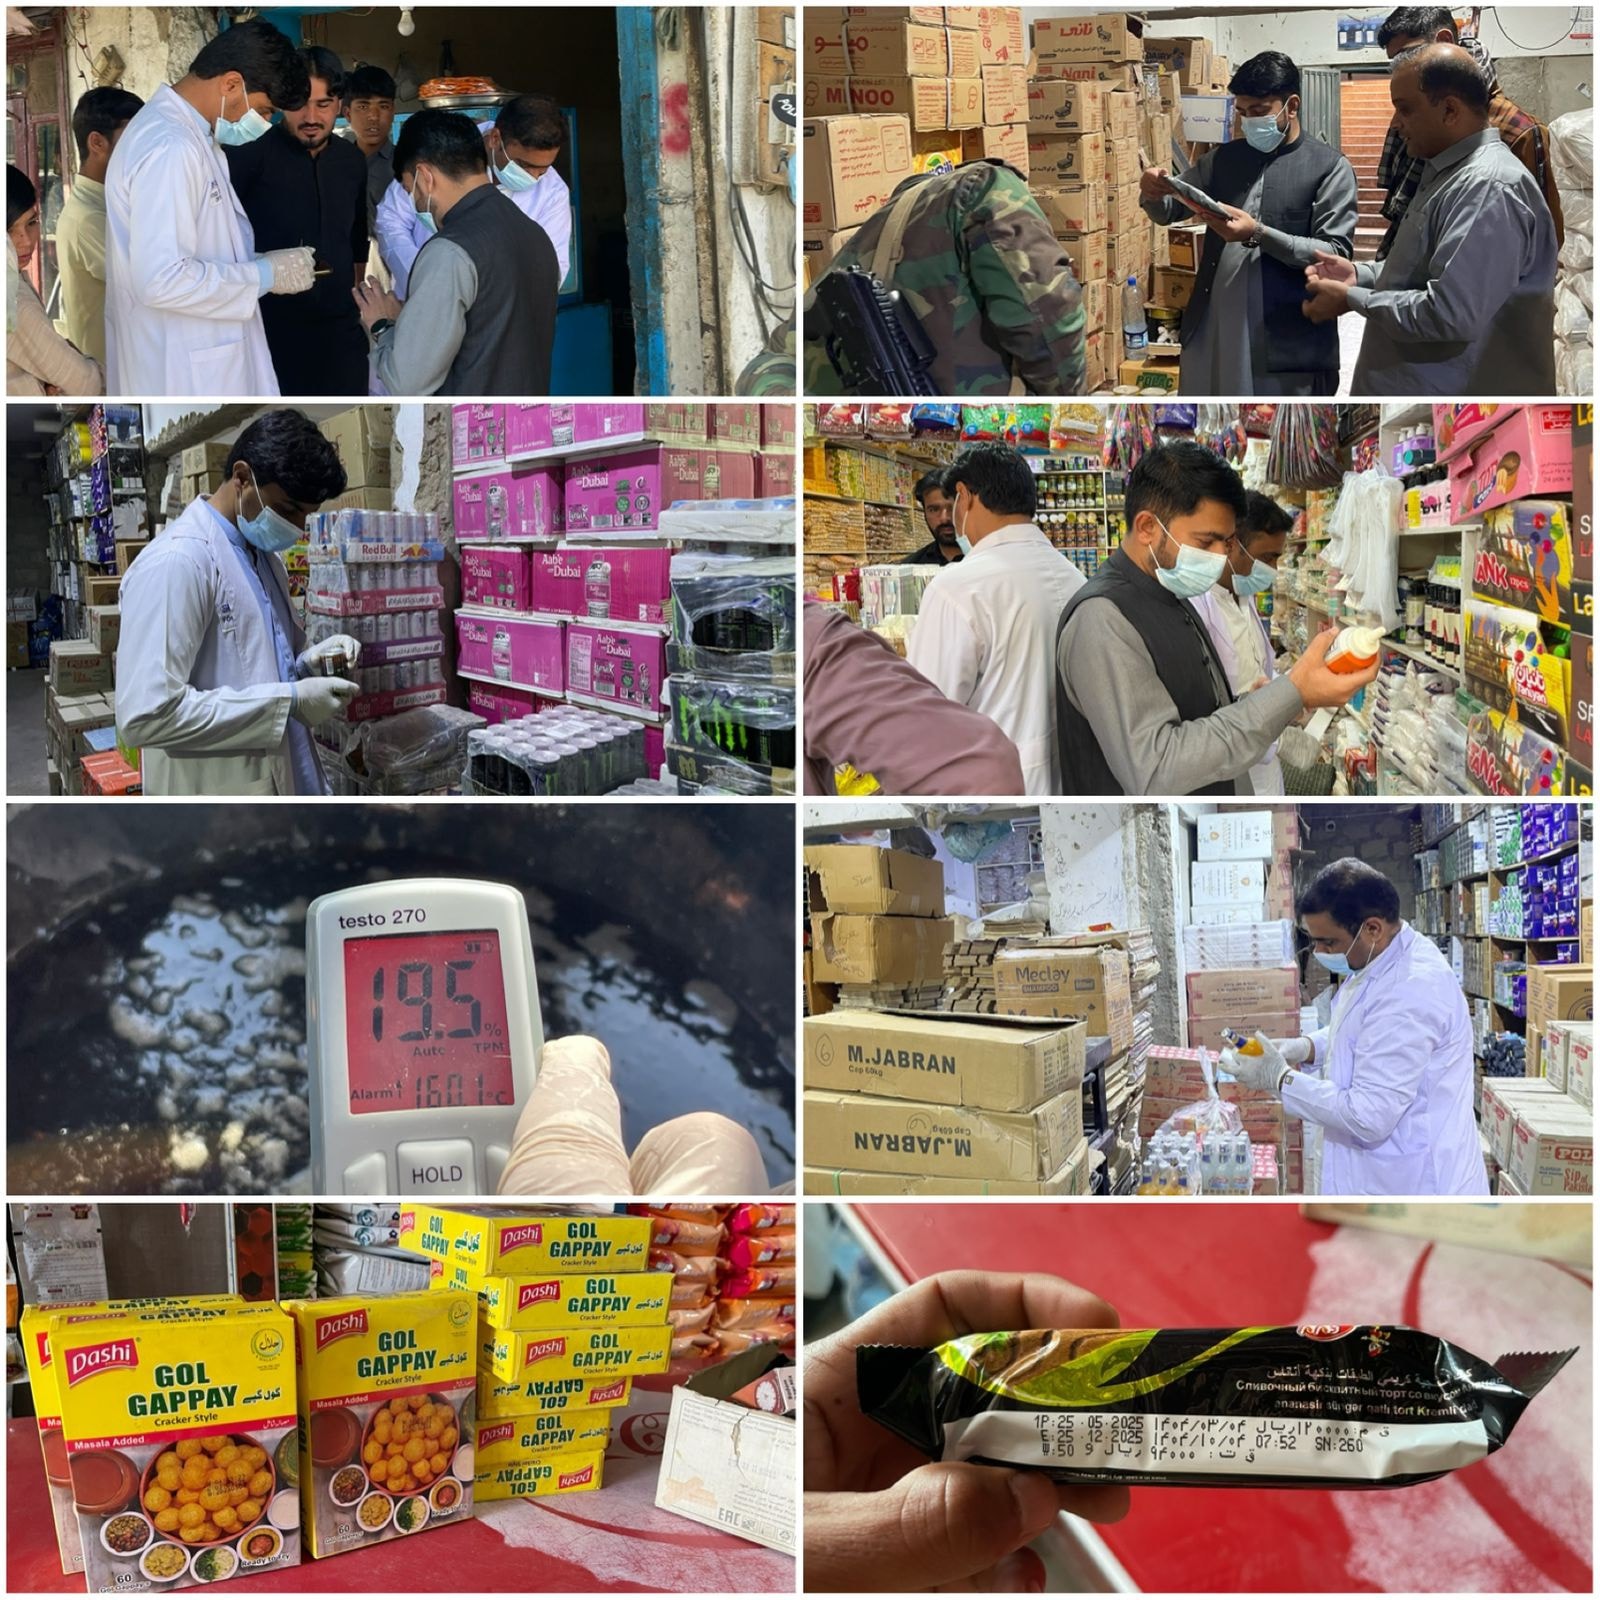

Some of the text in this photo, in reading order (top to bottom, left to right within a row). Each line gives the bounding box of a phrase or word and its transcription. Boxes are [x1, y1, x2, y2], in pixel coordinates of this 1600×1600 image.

[554, 565, 581, 577] Dubai
[339, 908, 427, 929] testo 270
[1016, 966, 1071, 984] Meclay
[372, 960, 482, 1042] 19.5
[413, 1046, 446, 1057] Auto
[848, 1045, 956, 1075] M.JABRAN
[350, 1088, 394, 1100] Alarm
[854, 1132, 972, 1157] M.JABRAN
[412, 1166, 463, 1184] HOLD
[1564, 1168, 1581, 1183] Sip
[430, 1216, 443, 1234] GOL
[567, 1222, 598, 1239] GOL
[421, 1233, 449, 1256] GAPPAY
[503, 1227, 540, 1247] Dashi
[550, 1241, 612, 1258] GAPPAY
[582, 1259, 597, 1267] Style
[522, 1284, 558, 1304] Dashi
[586, 1279, 616, 1294] GOL
[567, 1297, 632, 1312] GAPPAY
[139, 1309, 227, 1321] GAPPAY
[580, 1313, 616, 1322] Cracker Style
[320, 1314, 364, 1340] Dashi
[379, 1330, 417, 1352] GOL
[591, 1334, 619, 1349] GOL
[72, 1343, 132, 1375] Dashi
[529, 1341, 563, 1360] Dashi
[573, 1350, 632, 1366] GAPPAY
[357, 1350, 437, 1378] GAPPAY
[155, 1363, 210, 1387] GOL
[376, 1374, 422, 1387] Cracker Style
[526, 1378, 584, 1396] GAPPAY
[592, 1384, 623, 1402] Dashi
[1236, 1379, 1307, 1392] Сливочный
[1380, 1389, 1407, 1400] торт
[1408, 1391, 1423, 1400] со
[128, 1385, 238, 1417] GAPPAY
[317, 1395, 368, 1409] Masala Added
[540, 1396, 568, 1409] GOL
[1394, 1405, 1414, 1416] tort
[154, 1413, 218, 1427] Cracker Style
[536, 1415, 563, 1431] GOL
[74, 1436, 145, 1451] Masala Added
[481, 1427, 513, 1445] Dashi
[521, 1429, 575, 1447] GAPPAY
[1256, 1434, 1364, 1453] 07:52 SN:260
[496, 1466, 552, 1482] GAPPAY
[560, 1470, 591, 1487] Dashi
[510, 1481, 537, 1495] GOL
[339, 1524, 350, 1534] 60
[117, 1574, 132, 1584] 60
